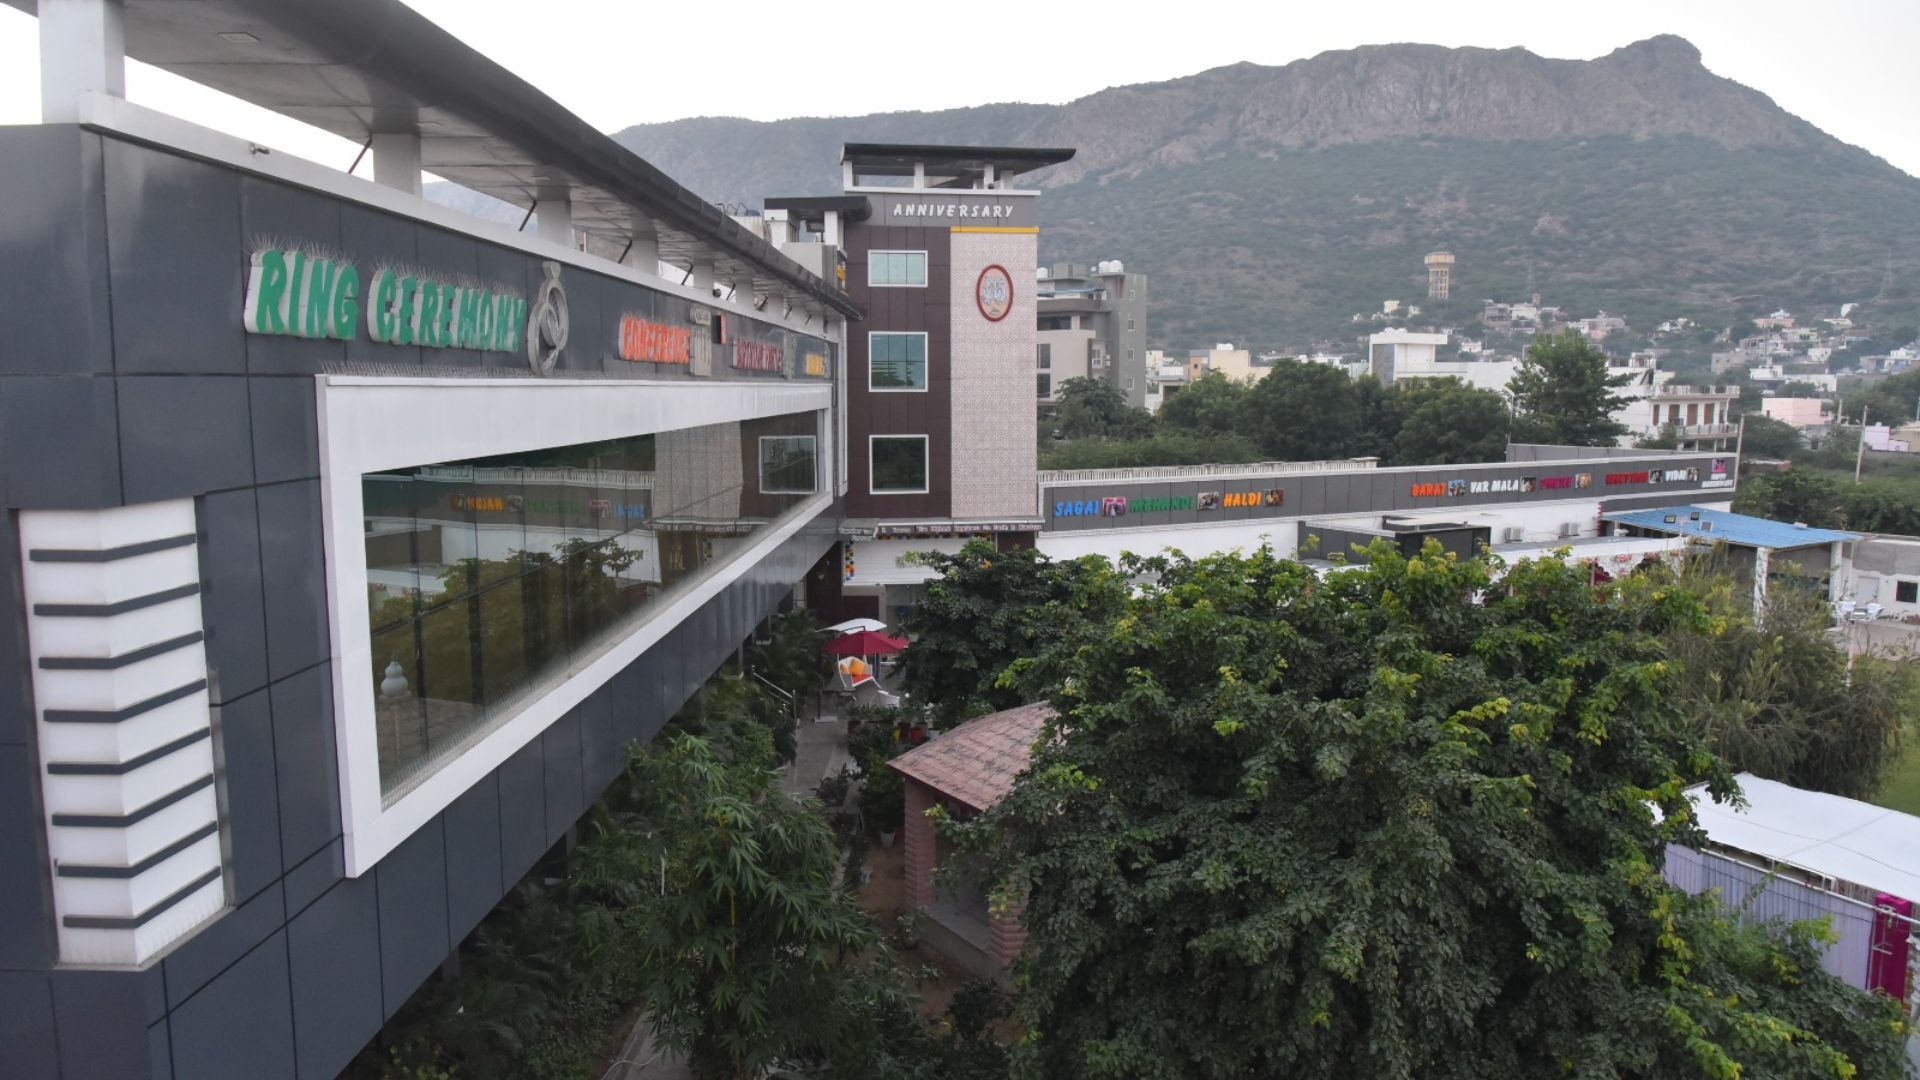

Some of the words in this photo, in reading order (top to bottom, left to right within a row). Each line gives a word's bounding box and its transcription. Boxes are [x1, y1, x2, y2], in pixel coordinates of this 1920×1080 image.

[893, 203, 1013, 218] ANNIVERSARY
[249, 249, 360, 340] RING
[369, 270, 528, 352] CEREMONY
[1411, 482, 1447, 497] BARAT
[1470, 481, 1490, 494] VAR
[1491, 479, 1519, 492] MALA
[1223, 491, 1263, 508] HALDI
[1055, 500, 1099, 517] SAGAI
